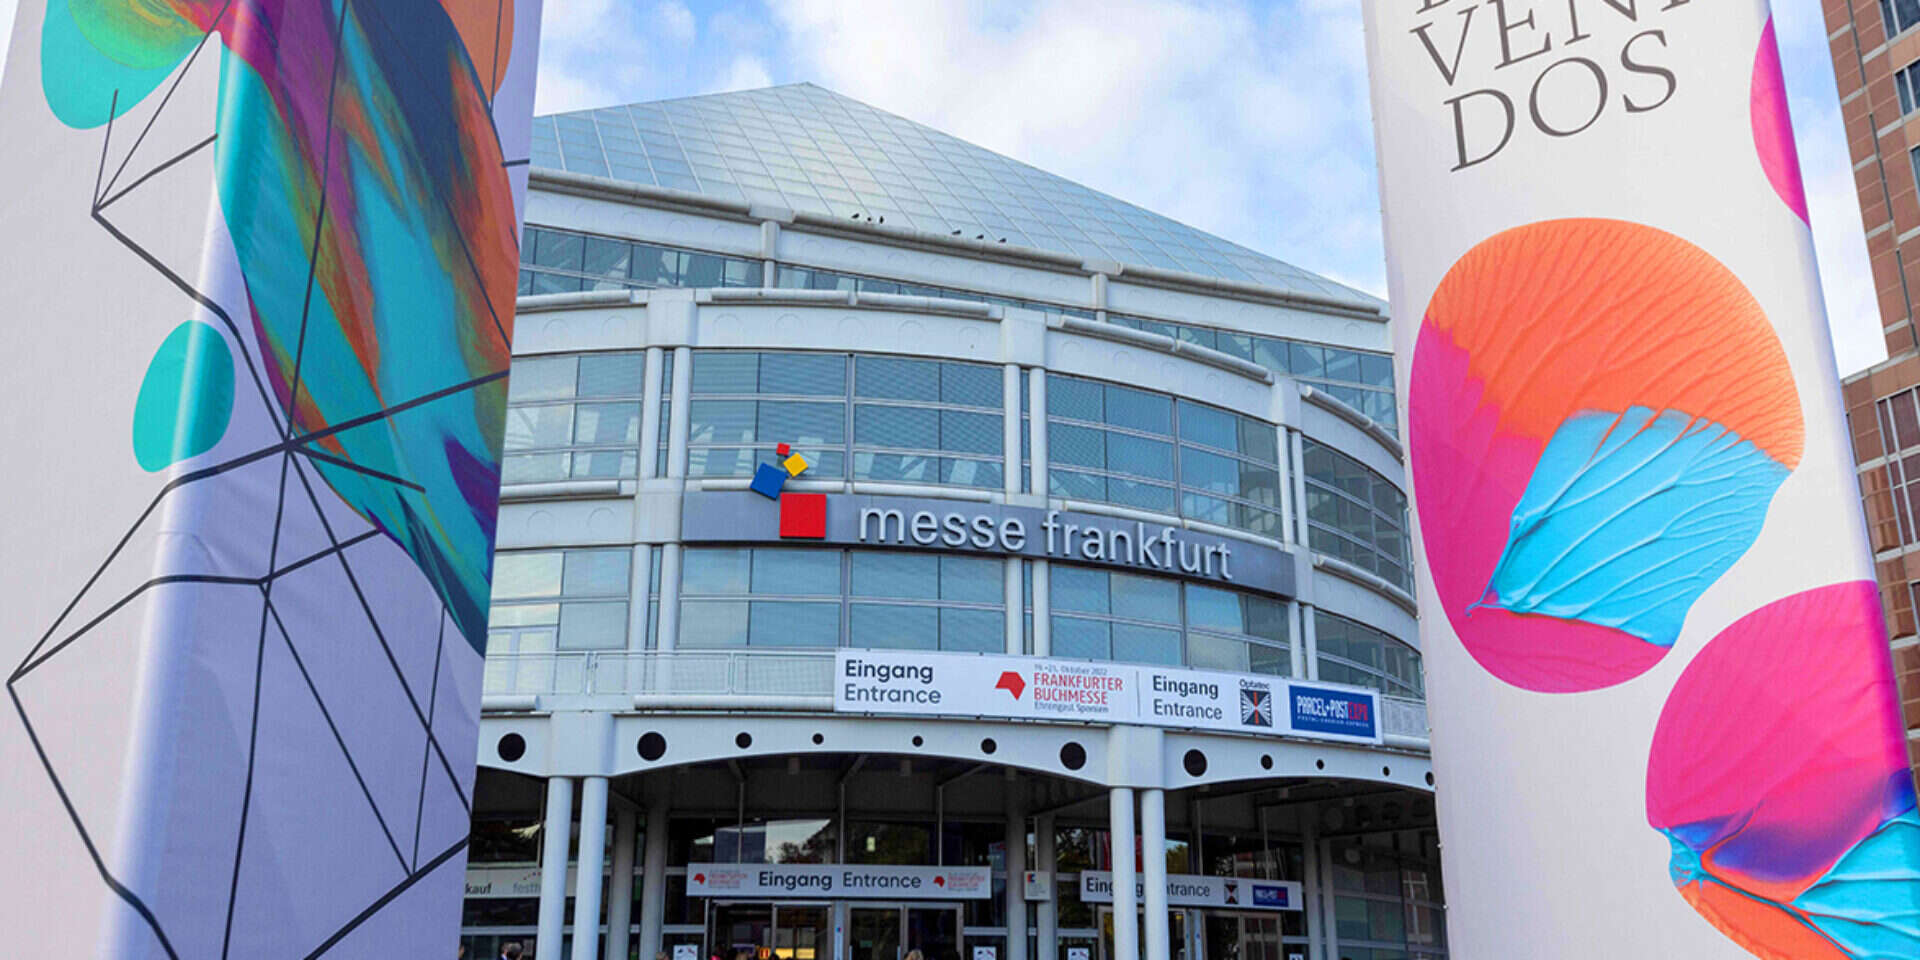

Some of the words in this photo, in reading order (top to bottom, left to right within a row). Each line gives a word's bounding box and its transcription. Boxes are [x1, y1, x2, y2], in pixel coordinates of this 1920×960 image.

[1443, 29, 1677, 172] DOS
[858, 505, 1027, 551] messe
[1042, 508, 1233, 581] frankfurt
[844, 659, 934, 685] Eingang
[1033, 672, 1123, 691] FRANKFURTER
[844, 683, 942, 704] Entrance
[1033, 687, 1108, 705] BUCHMESSE
[1152, 675, 1219, 698] Eingang
[1153, 698, 1223, 720] Entrance
[758, 871, 833, 891] Eingang
[842, 871, 922, 889] Entrance
[1085, 876, 1144, 897] Eingg
